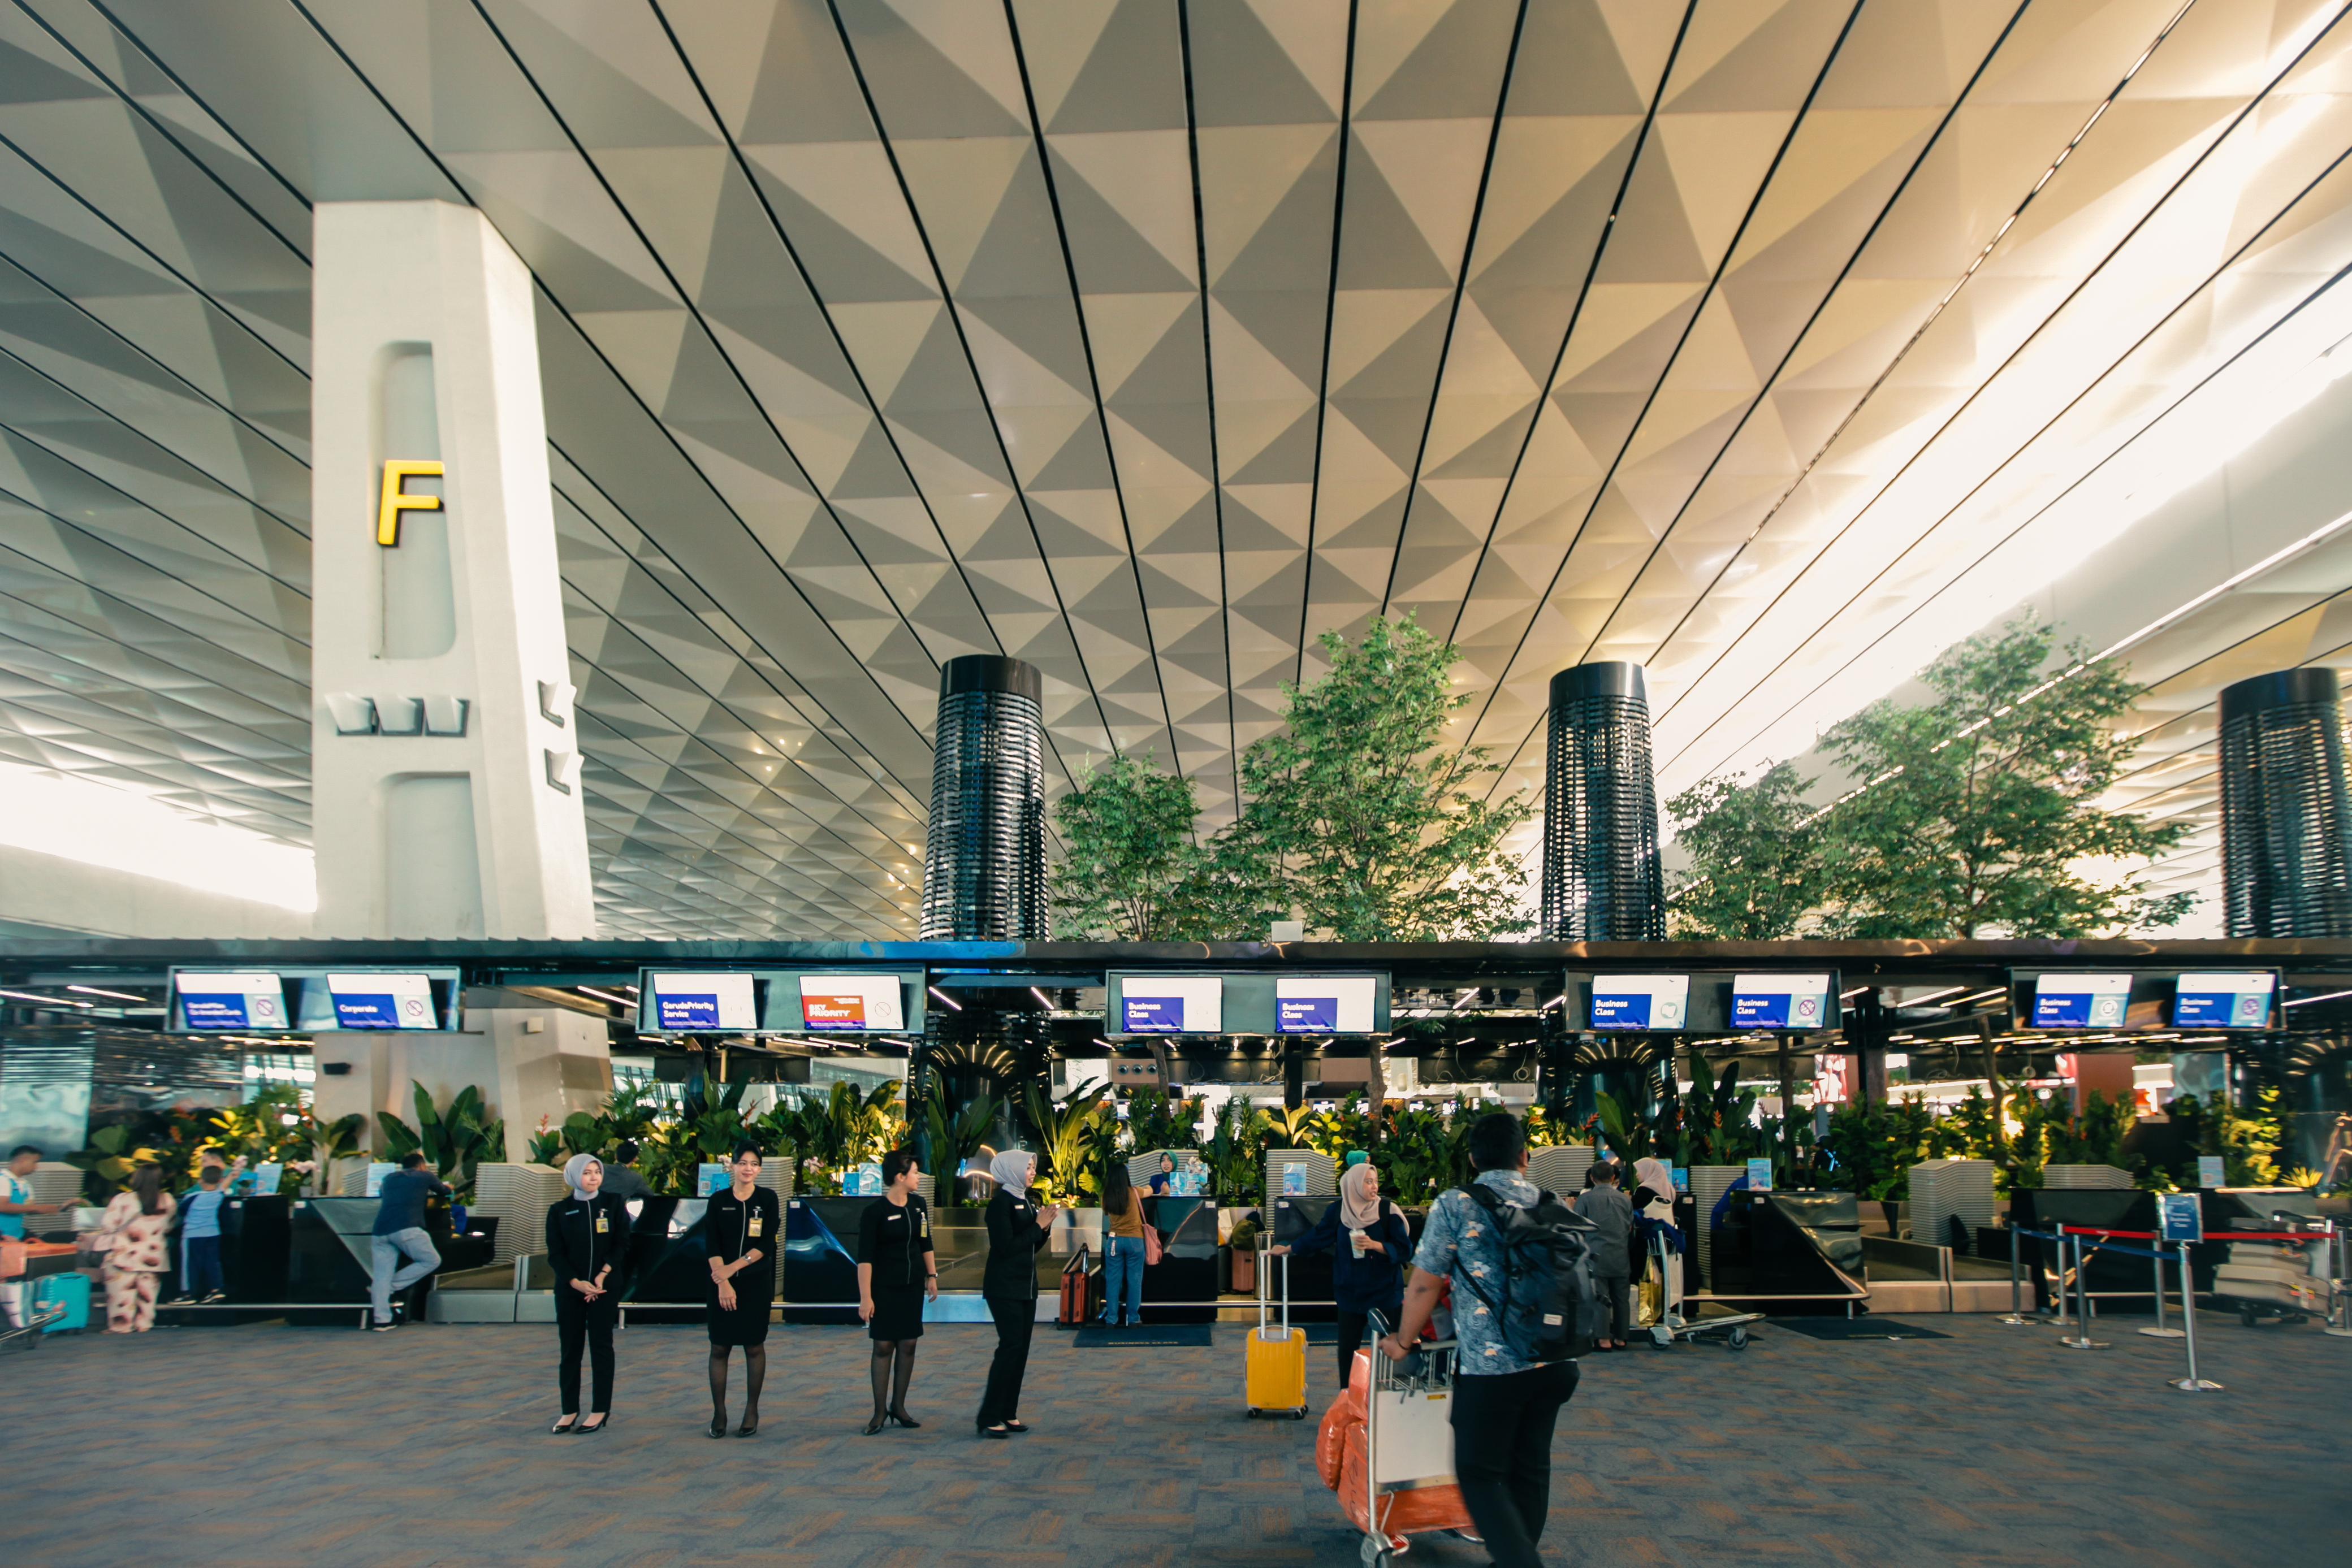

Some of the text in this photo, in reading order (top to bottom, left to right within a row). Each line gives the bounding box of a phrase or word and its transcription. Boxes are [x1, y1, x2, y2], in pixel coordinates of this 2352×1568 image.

[377, 460, 444, 547] F
[663, 1001, 715, 1011] GarudaPriority
[1596, 999, 1628, 1008] Business
[339, 1004, 378, 1013] Corporate
